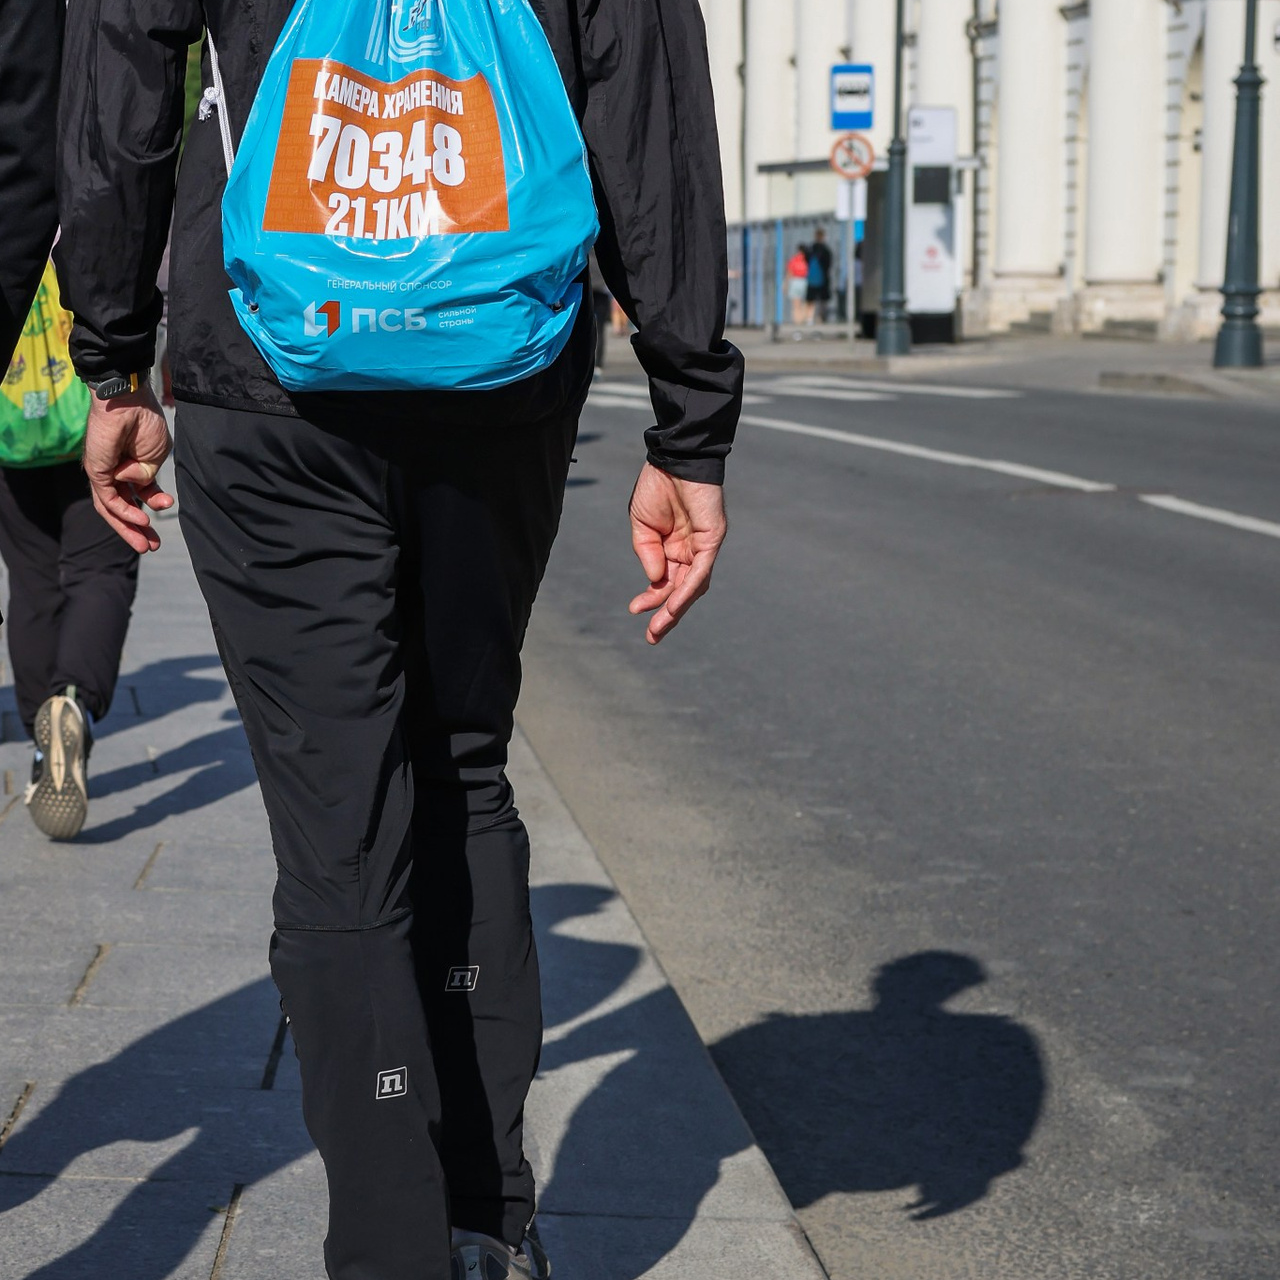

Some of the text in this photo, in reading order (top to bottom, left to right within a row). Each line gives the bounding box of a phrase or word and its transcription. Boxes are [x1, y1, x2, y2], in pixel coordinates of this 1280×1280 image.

[313, 71, 464, 119] КАМЕРА ХРАНЕНИЯ
[307, 114, 466, 193] 70348
[327, 279, 453, 292] ГЕНЕРАЛЬНЫЙ СПОНСОР
[352, 307, 427, 333] ПСБ
[438, 306, 477, 319] сильной
[439, 317, 474, 329] страны
